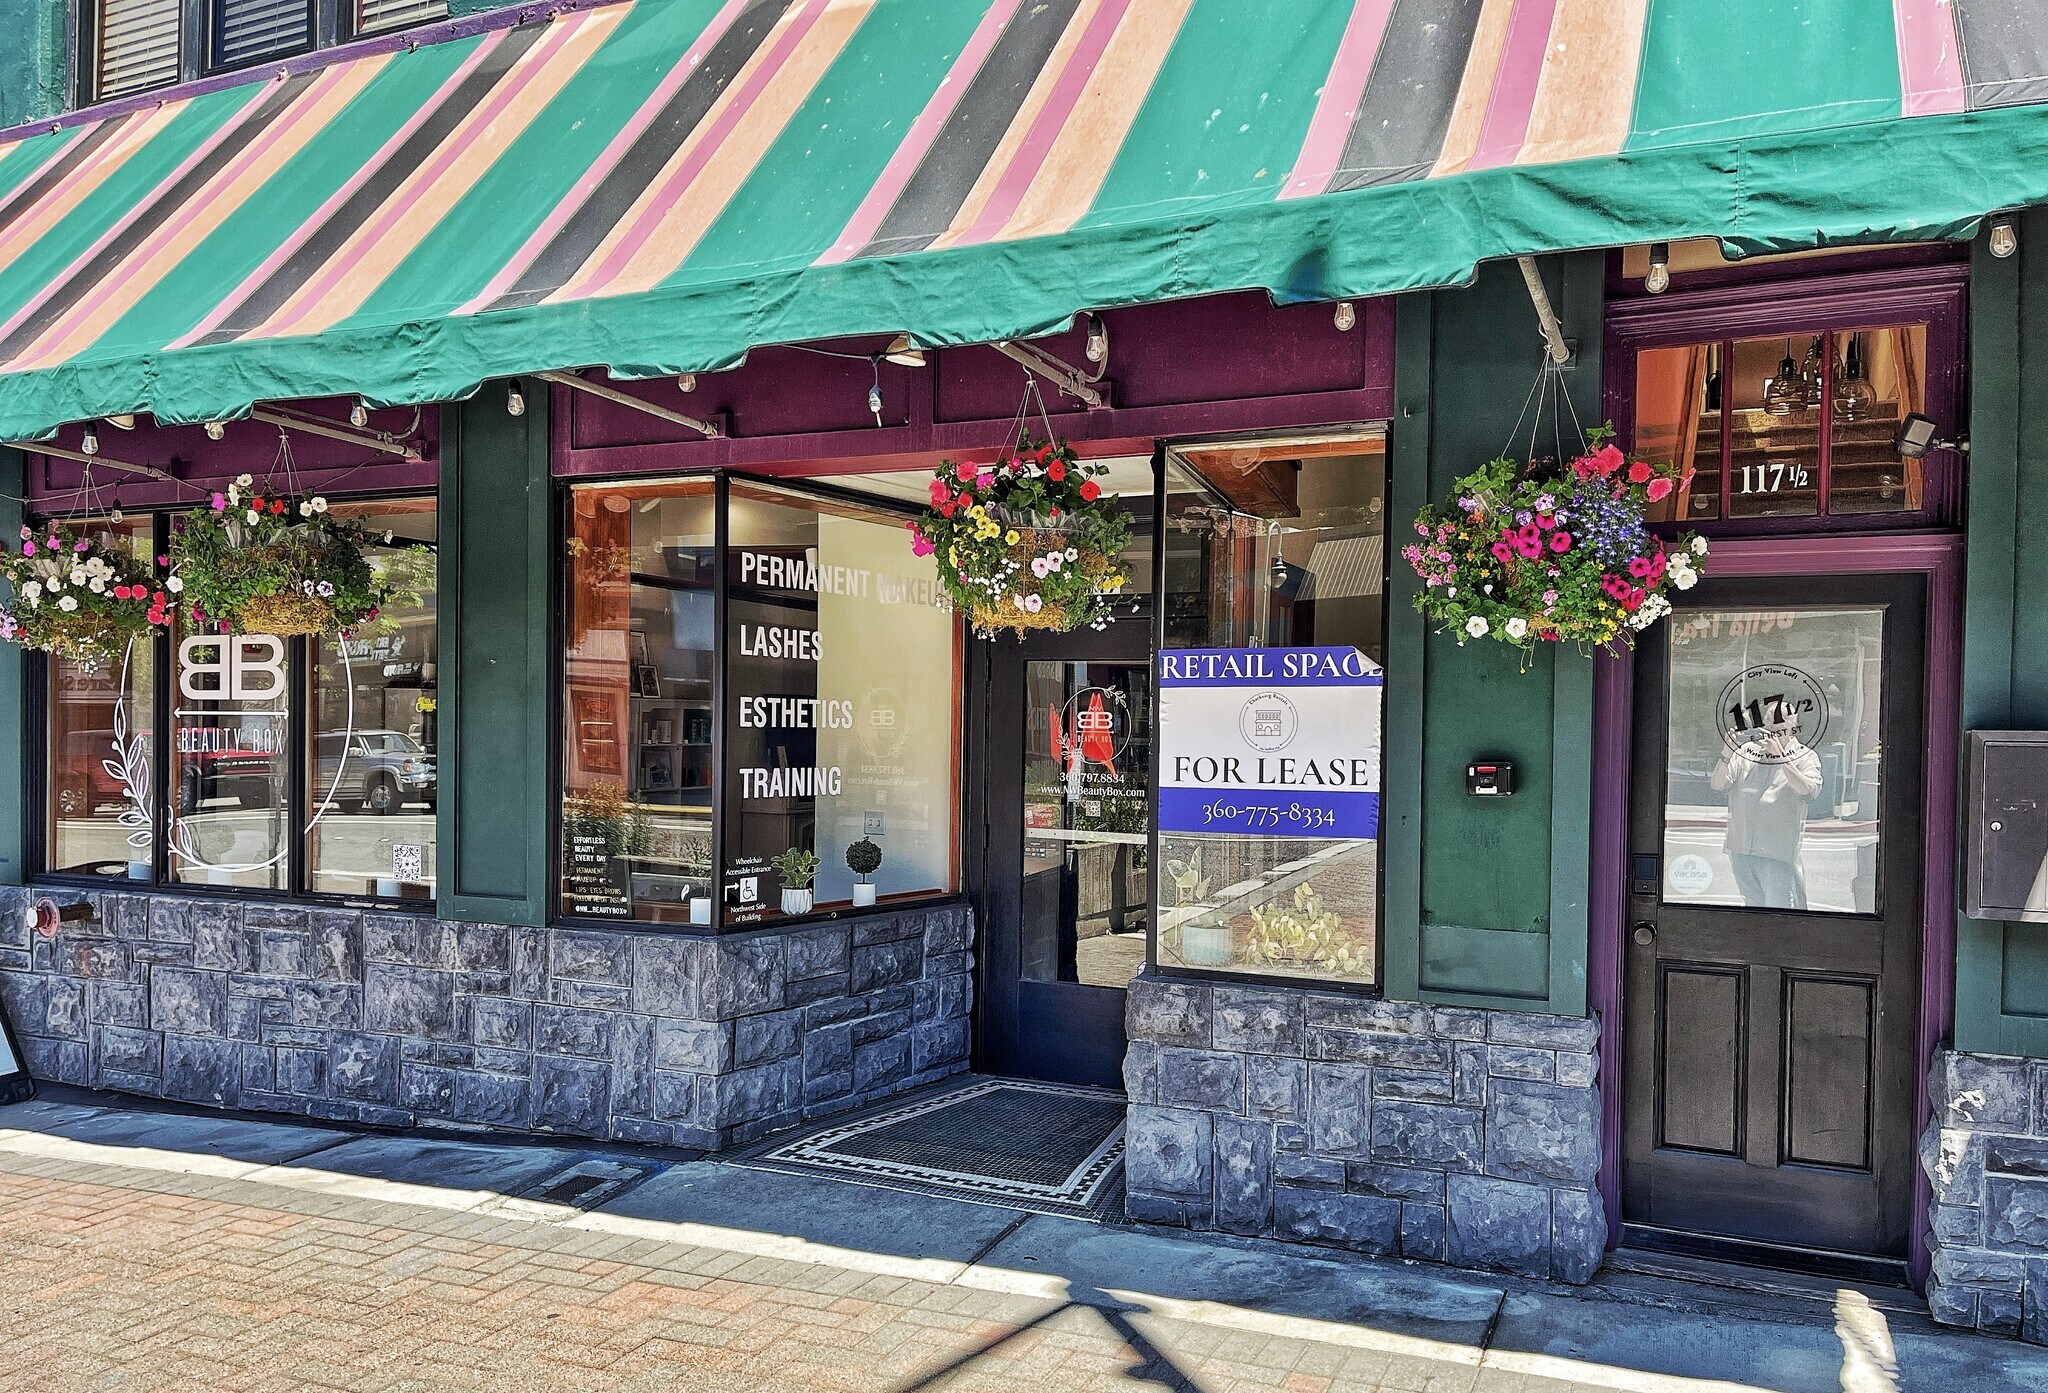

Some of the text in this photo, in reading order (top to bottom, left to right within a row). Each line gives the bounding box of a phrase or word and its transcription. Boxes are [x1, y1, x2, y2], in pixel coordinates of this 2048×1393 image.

[1741, 464, 1784, 493] 117
[741, 551, 942, 607] PERMANENT MAKEU
[740, 624, 824, 661] LASHES
[1161, 653, 1274, 679] RETAIL
[1747, 670, 1763, 679] City
[1783, 669, 1798, 679] Loft
[740, 696, 853, 729] ESTHETICS
[1791, 725, 1803, 735] ST
[181, 727, 283, 754] BEAUTY BOX
[1746, 747, 1763, 758] Water
[1781, 749, 1795, 757] Loft
[1174, 756, 1368, 788] FOR LEASE
[739, 766, 841, 799] TRAINING
[1040, 785, 1145, 797] www.NWBeautyBox.com
[1203, 798, 1335, 828] 360-775-8334
[573, 836, 606, 844] EFFORTLESS
[574, 845, 594, 853] BEAUTY
[735, 857, 763, 865] Wheelchair
[725, 866, 772, 876] Accessible Entrance
[730, 905, 755, 914] Northwest
[735, 913, 762, 922] of Building
